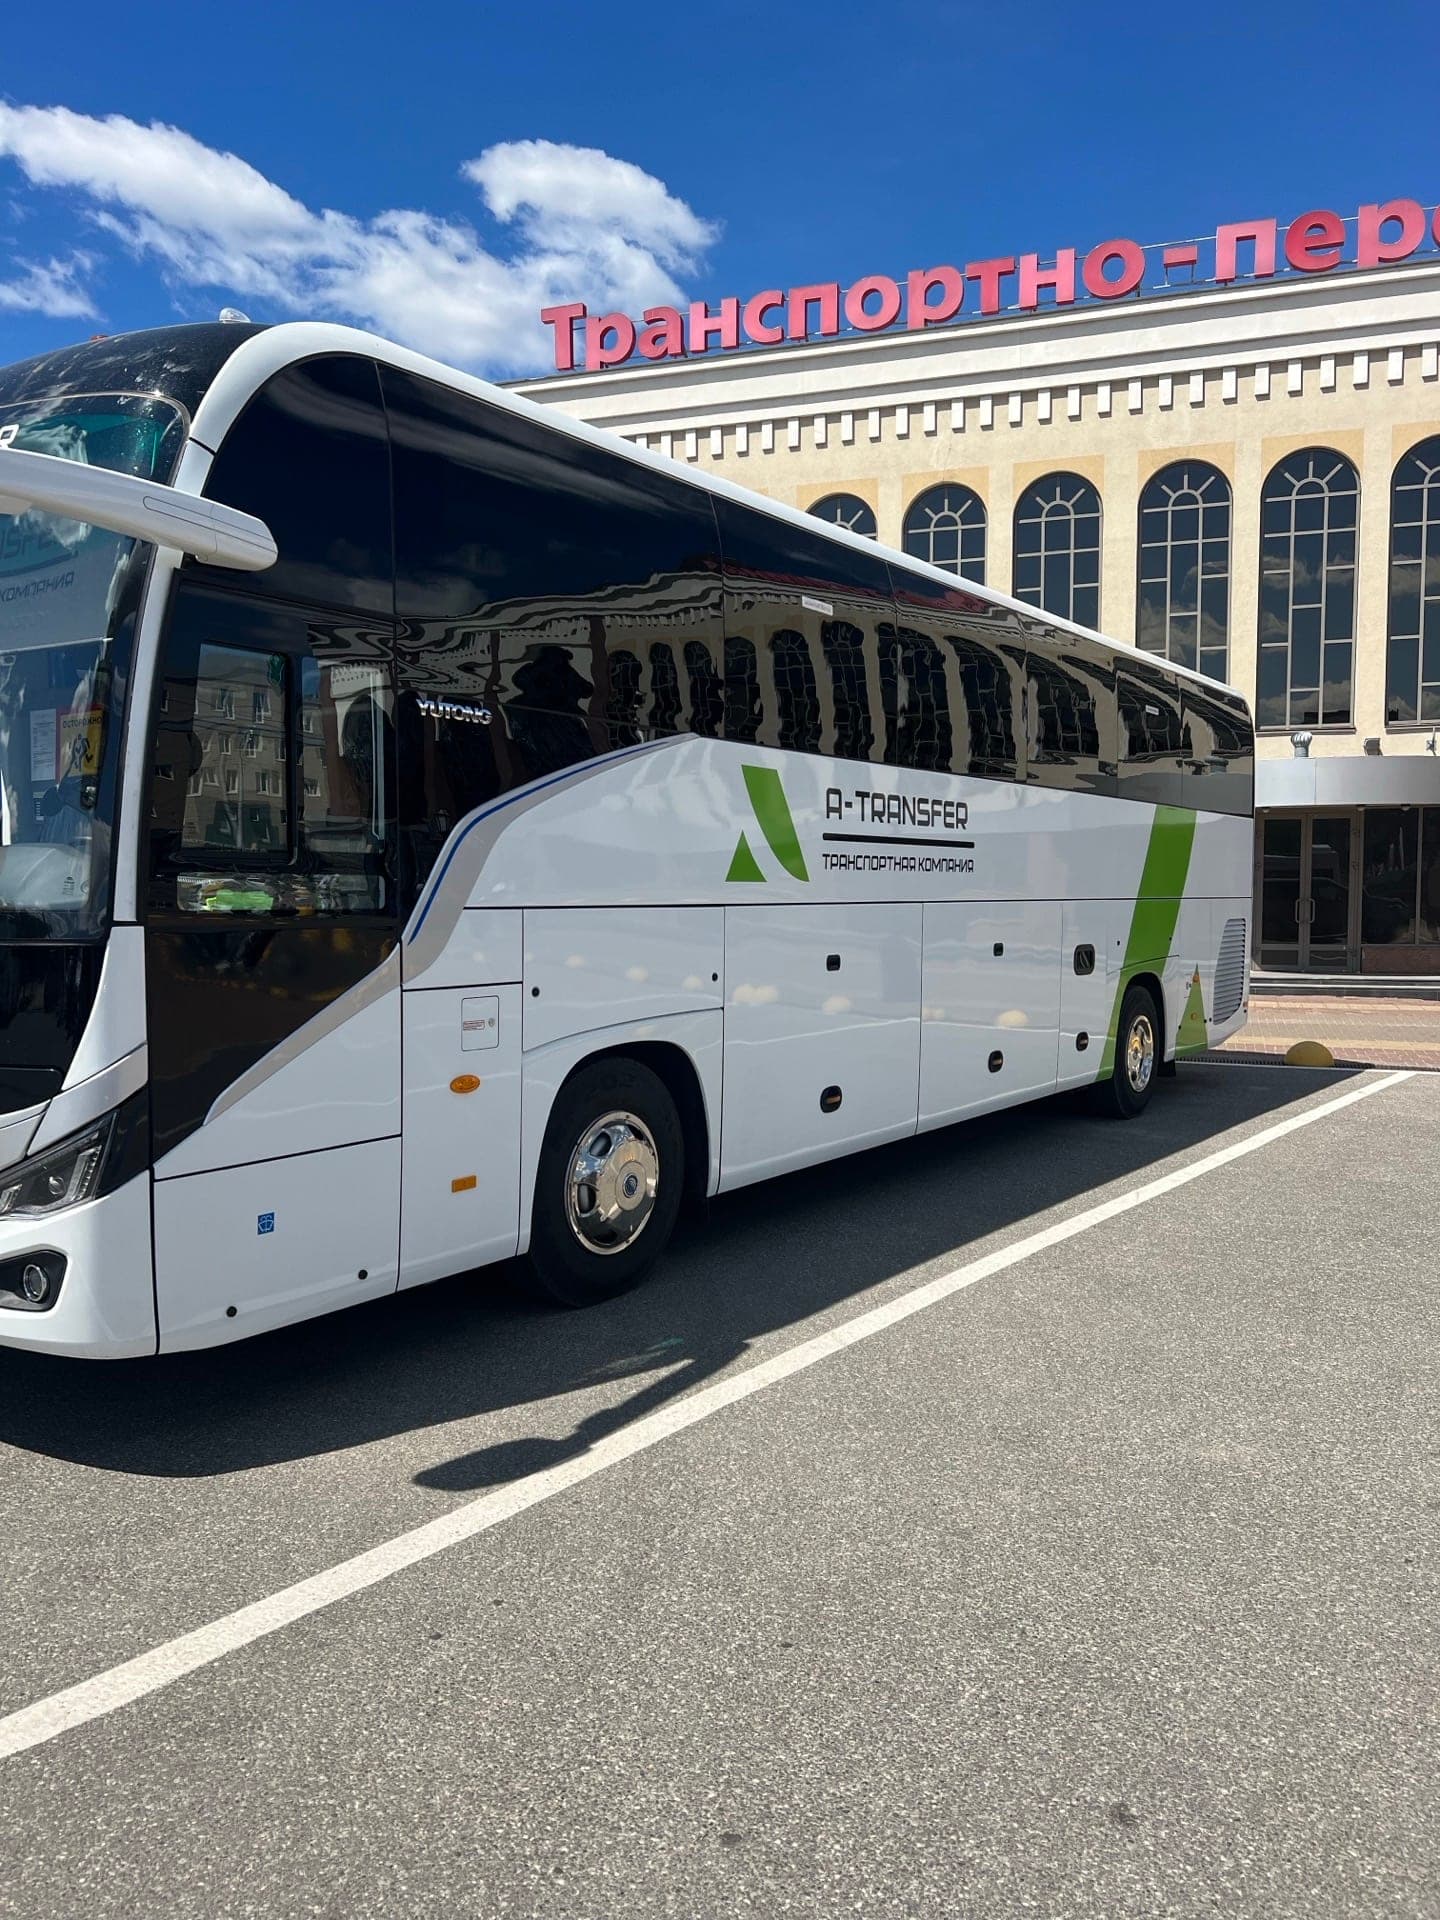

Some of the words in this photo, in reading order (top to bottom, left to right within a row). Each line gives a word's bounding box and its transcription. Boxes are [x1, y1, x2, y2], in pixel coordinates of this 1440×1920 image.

[416, 698, 493, 725] YUTONG
[826, 787, 968, 830] A-TRANSFER
[822, 853, 916, 872] ТРАНСПОРТНАЯ
[918, 857, 975, 873] КОМПАНИЯ
